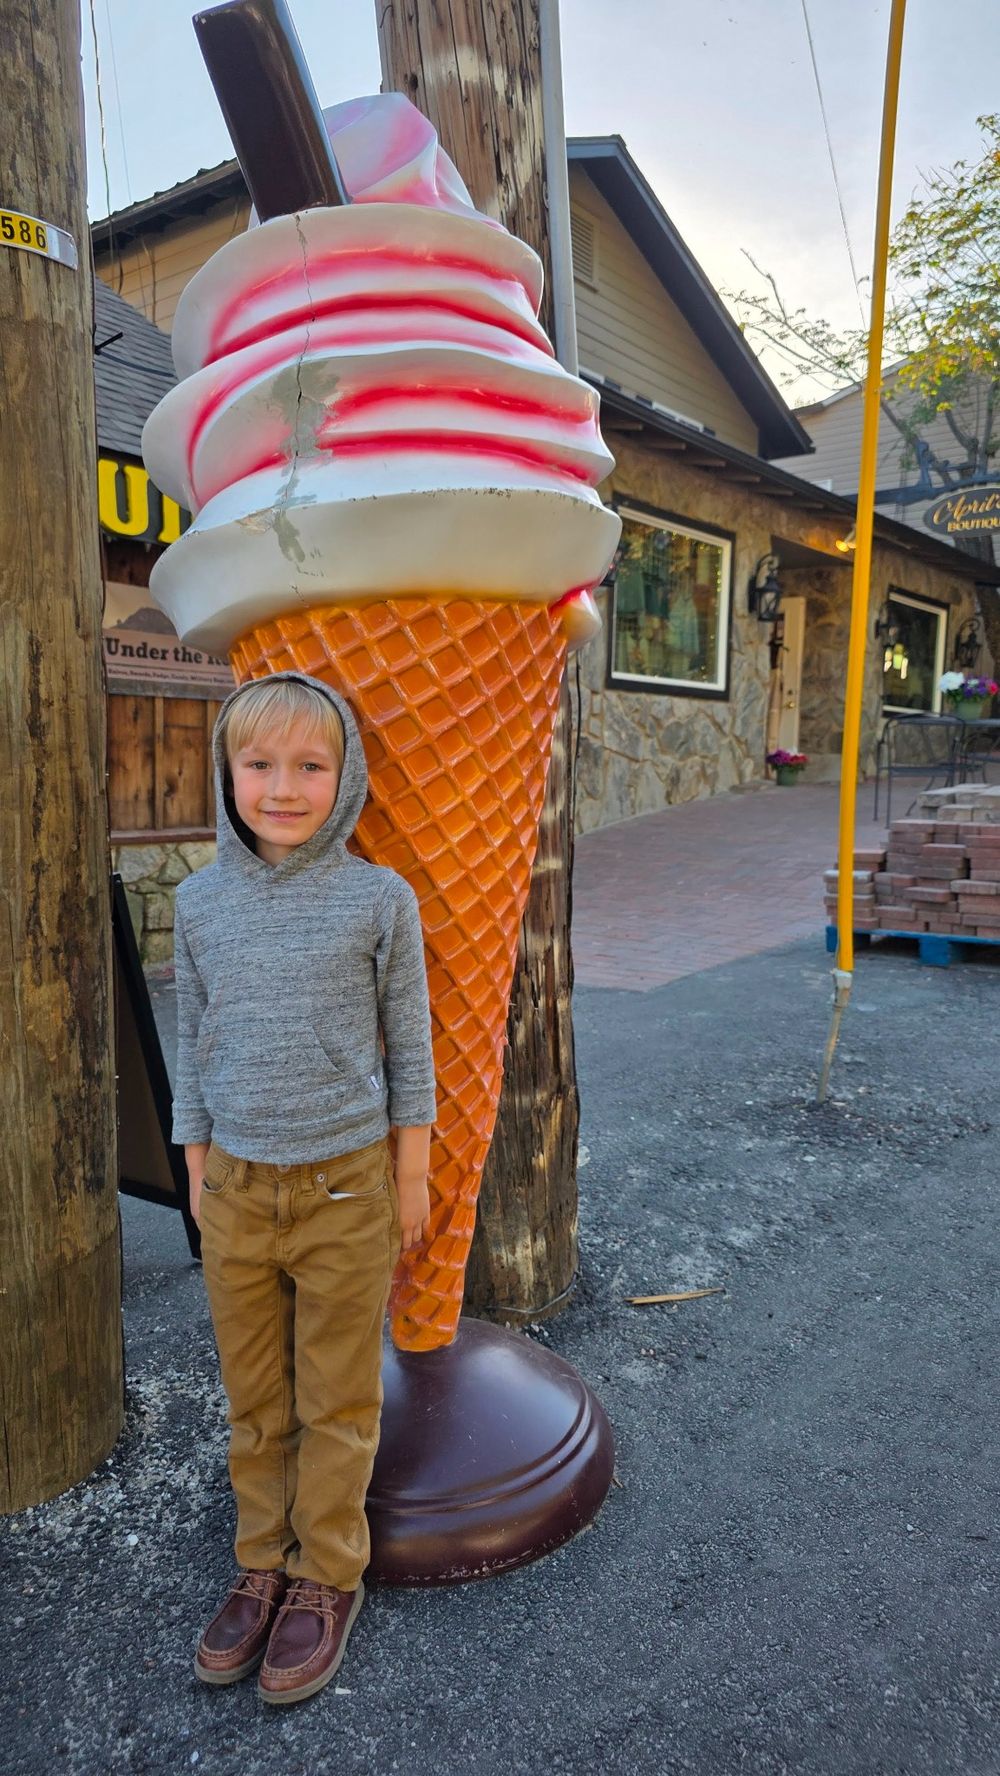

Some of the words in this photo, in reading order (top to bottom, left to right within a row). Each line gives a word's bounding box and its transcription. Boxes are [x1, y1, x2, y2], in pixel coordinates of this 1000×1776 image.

[1, 215, 47, 249] 586
[105, 637, 169, 661] Under
[173, 646, 202, 664] the
